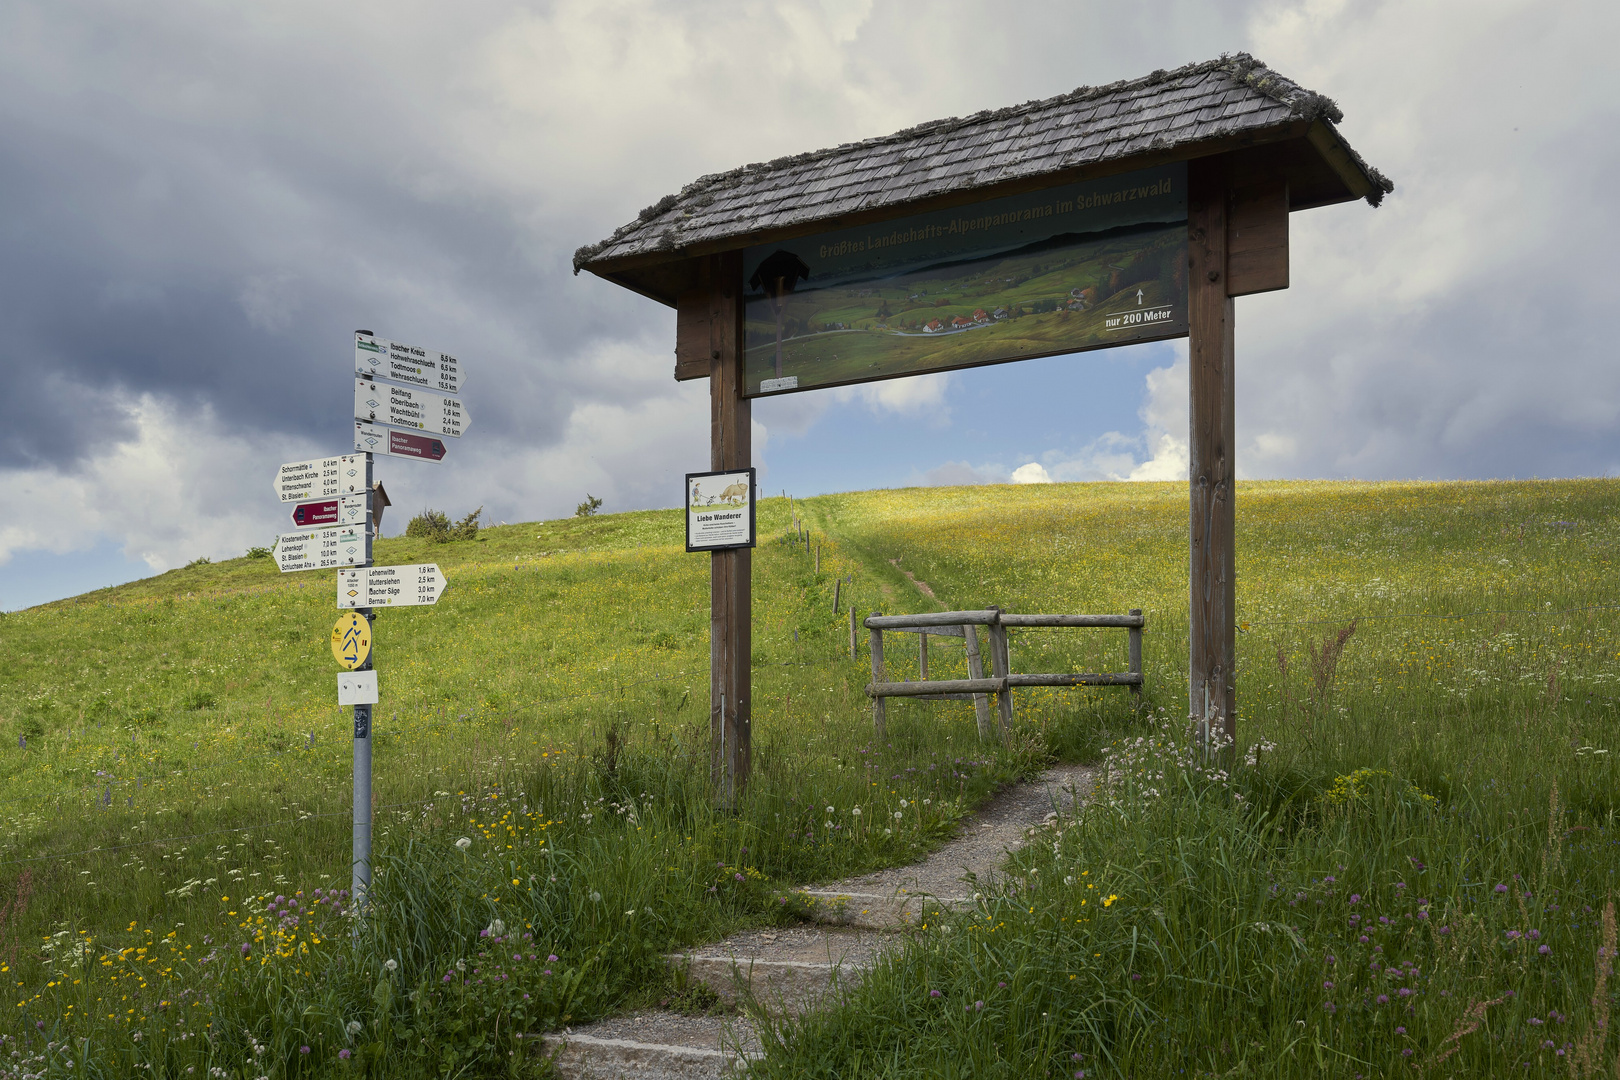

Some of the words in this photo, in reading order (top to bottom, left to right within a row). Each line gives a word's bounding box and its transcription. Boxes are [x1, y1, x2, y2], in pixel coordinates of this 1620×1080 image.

[820, 241, 865, 258] Größtes
[867, 204, 1053, 250] Landschafts-Alpenpanorama
[1056, 200, 1073, 214] im
[1077, 178, 1172, 210] Schwarzwald
[1105, 318, 1121, 327] nur
[1123, 312, 1142, 325] 200
[1144, 310, 1172, 322] Meter
[441, 354, 449, 363] 5,5
[391, 361, 416, 373] Todtmoos
[441, 372, 449, 381] 8,0
[441, 363, 449, 372] 6,5
[391, 371, 428, 385] Wehraschlucht
[438, 381, 449, 390] 15,5
[452, 400, 460, 408] km
[452, 410, 460, 418] km
[391, 415, 418, 428] Todtmoos
[442, 426, 451, 435] 8,0
[451, 428, 460, 436] km
[442, 417, 451, 426] 2,4
[451, 419, 460, 427] km
[697, 514, 713, 522] Liebe
[713, 513, 742, 521] Wanderer
[418, 576, 427, 584] 2,5
[426, 585, 434, 593] km
[369, 597, 387, 605] Bernau
[417, 595, 426, 603] 7,0
